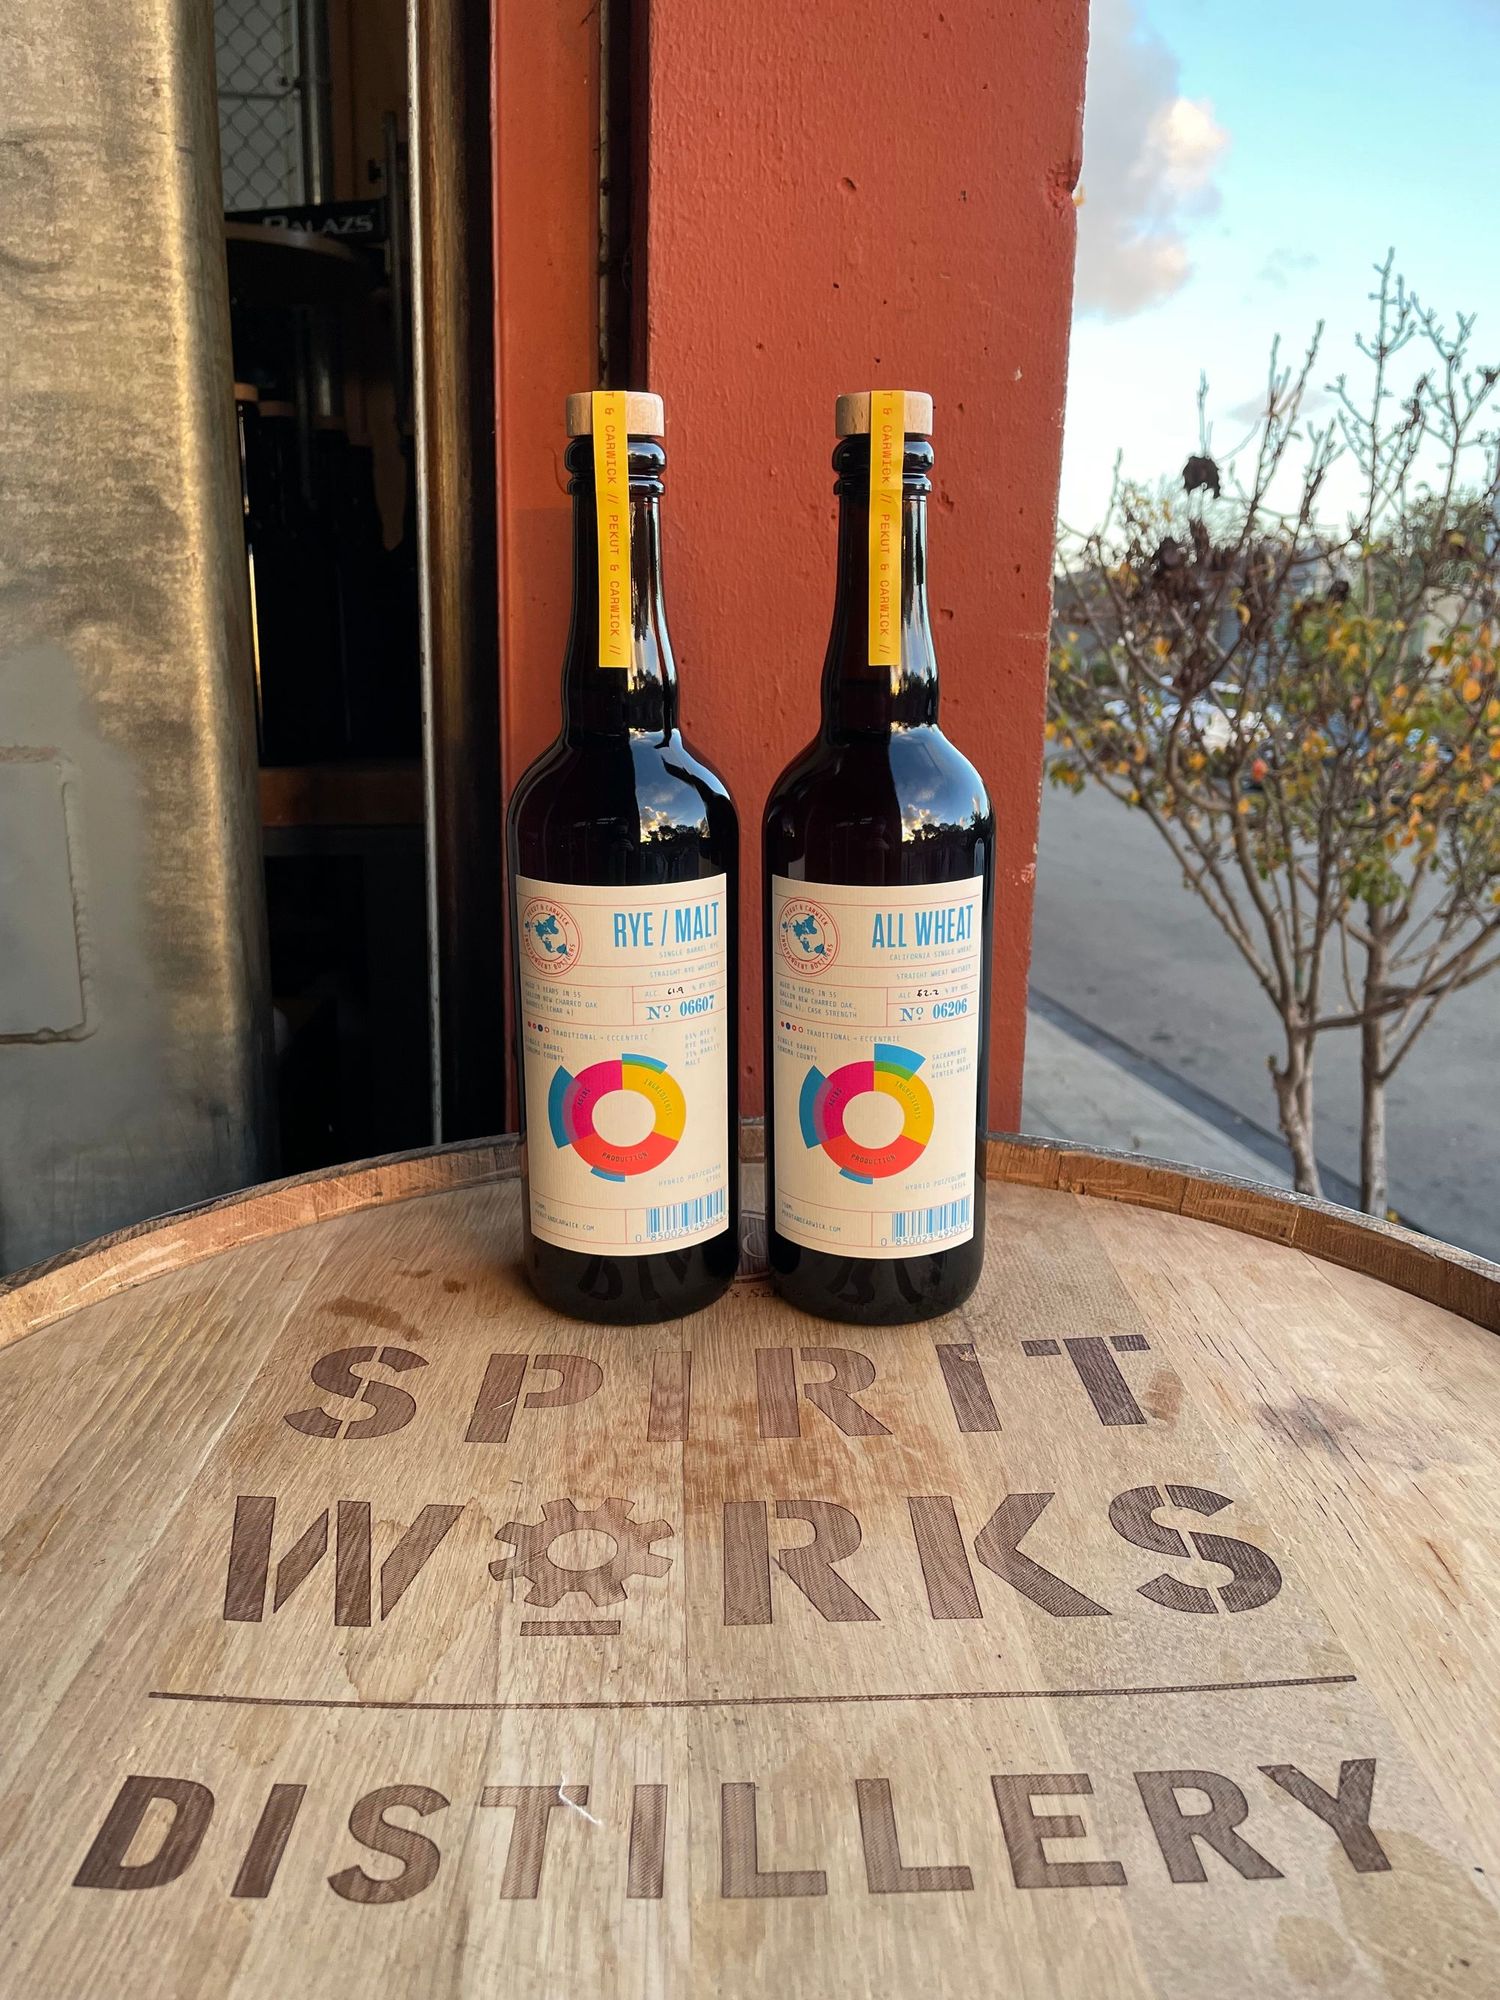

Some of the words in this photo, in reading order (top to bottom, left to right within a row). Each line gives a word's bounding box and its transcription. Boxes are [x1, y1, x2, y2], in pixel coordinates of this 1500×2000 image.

[605, 425, 616, 484] CARWICK
[882, 425, 892, 484] CARWICK
[608, 514, 620, 555] PEKUT
[880, 514, 890, 554] PEKUT
[610, 580, 620, 636] CARWICK
[880, 580, 889, 635] CARWICK
[614, 912, 654, 947] RYE
[661, 910, 668, 946] /
[675, 902, 719, 943] MALT
[872, 913, 907, 948] ALL
[915, 904, 973, 946] WHEAT
[659, 948, 682, 958] SINGLE
[686, 944, 707, 954] BARREL
[889, 951, 930, 960] CALIFORNIA
[649, 968, 683, 978] STRAIGHT
[684, 965, 695, 973] RYE
[896, 972, 927, 980] STRAIGHT
[930, 969, 948, 977] WHEAT
[562, 989, 570, 997] IN
[798, 987, 815, 995] YEARS
[556, 997, 582, 1007] CHARRED
[680, 995, 714, 1016] 06607
[811, 998, 837, 1008] CHARRED
[933, 998, 967, 1019] 06206
[807, 1006, 822, 1015] CASK
[825, 1008, 857, 1018] STRENGTH
[552, 1029, 598, 1041] TRADITIONAL
[807, 1028, 850, 1041] TRADITIONAL
[797, 1053, 818, 1061] COUNTY
[932, 1060, 954, 1069] VALLEY
[602, 1151, 648, 1163] PRODUCTION
[851, 1153, 896, 1165] PRODUCTION
[635, 1234, 641, 1242] 0
[650, 1227, 689, 1241] 850023
[881, 1238, 887, 1246] 0
[896, 1233, 934, 1246] 850023
[283, 1334, 1150, 1442] SPIRIT
[71, 1758, 1391, 1903] DISTILLERY
